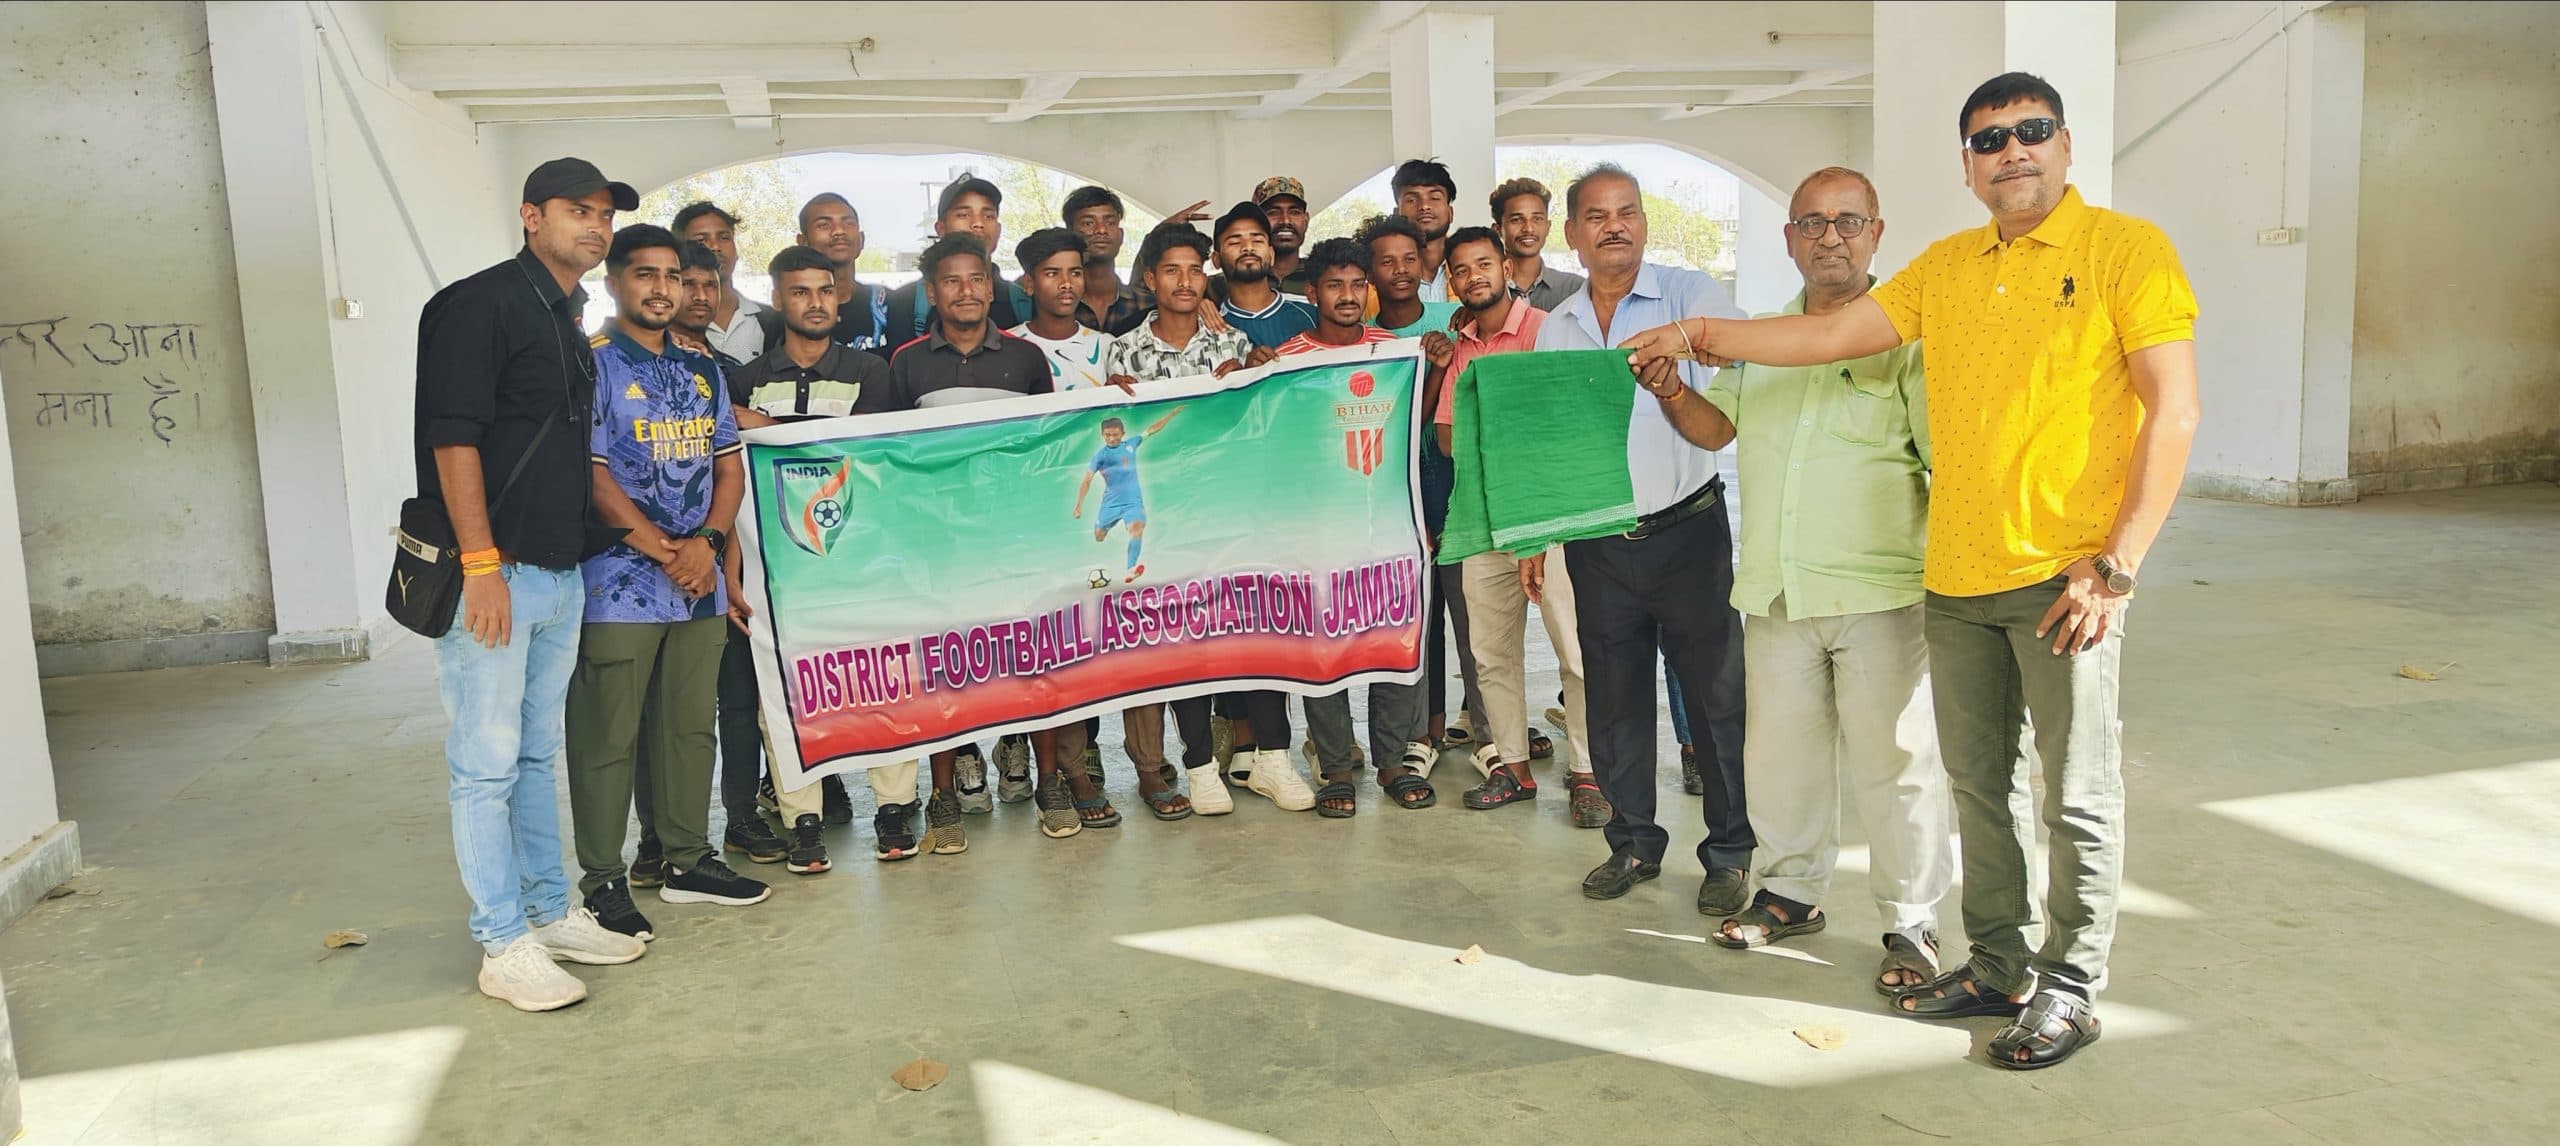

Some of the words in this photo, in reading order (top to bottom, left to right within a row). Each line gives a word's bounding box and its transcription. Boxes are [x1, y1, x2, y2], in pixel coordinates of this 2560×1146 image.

[83, 323, 202, 370] आना
[37, 392, 113, 427] मना
[1337, 403, 1391, 416] BIHAR
[786, 465, 832, 479] INDIA
[796, 640, 913, 718] DISTRICT
[918, 599, 1094, 692] FOOTBALL
[1100, 571, 1315, 653] ASSOCIATION
[1322, 555, 1416, 638] JAMUI
